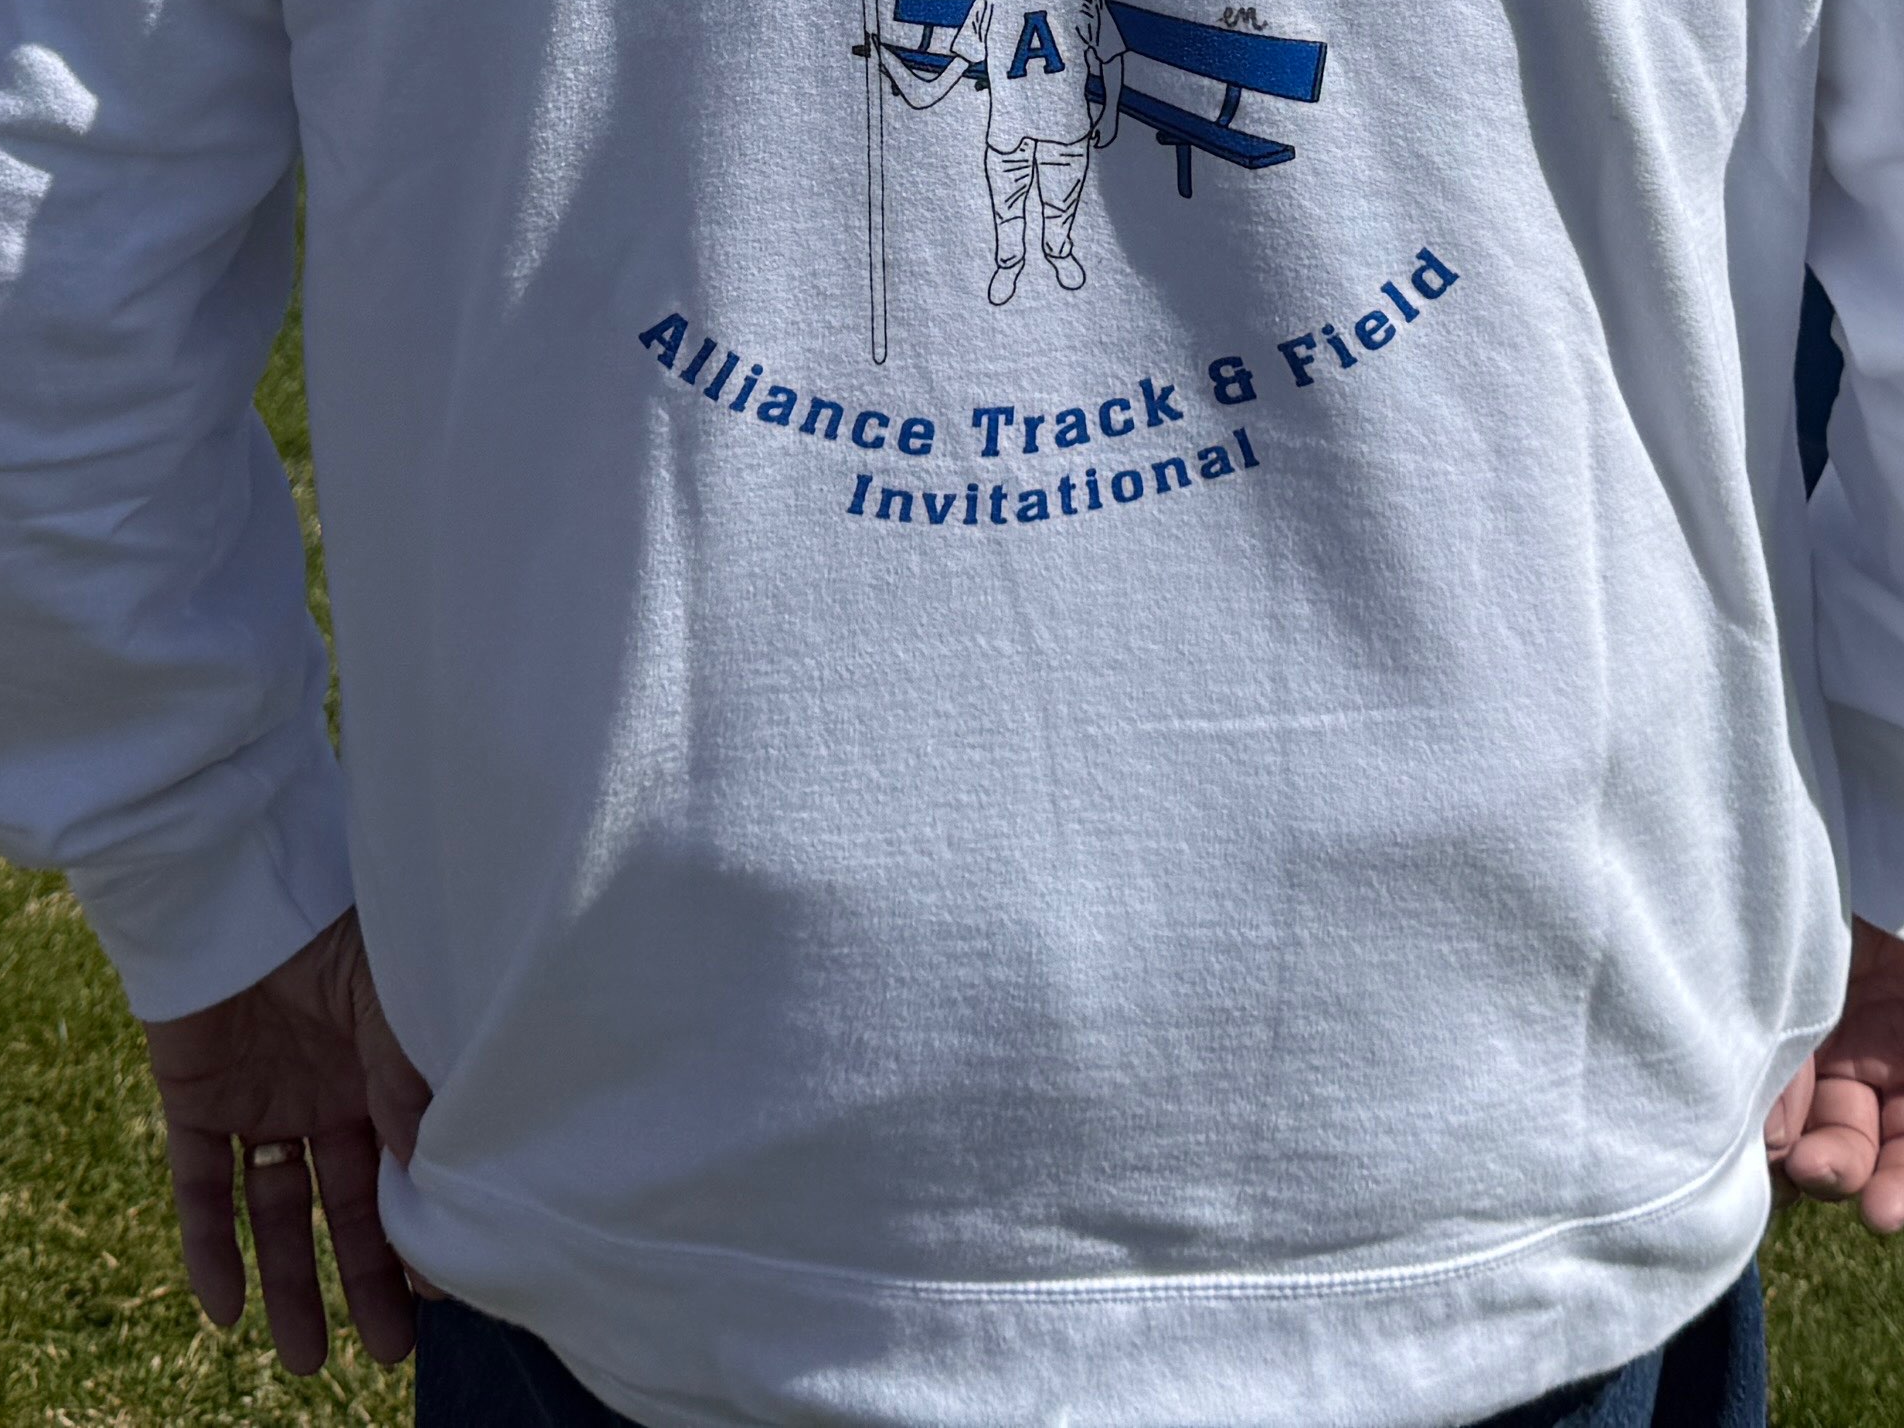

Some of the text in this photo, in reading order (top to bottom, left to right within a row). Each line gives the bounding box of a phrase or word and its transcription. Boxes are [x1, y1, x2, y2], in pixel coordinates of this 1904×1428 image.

[1006, 10, 1066, 80] A
[638, 246, 1461, 458] Alliance Track & Field
[846, 426, 1261, 526] Invitational
